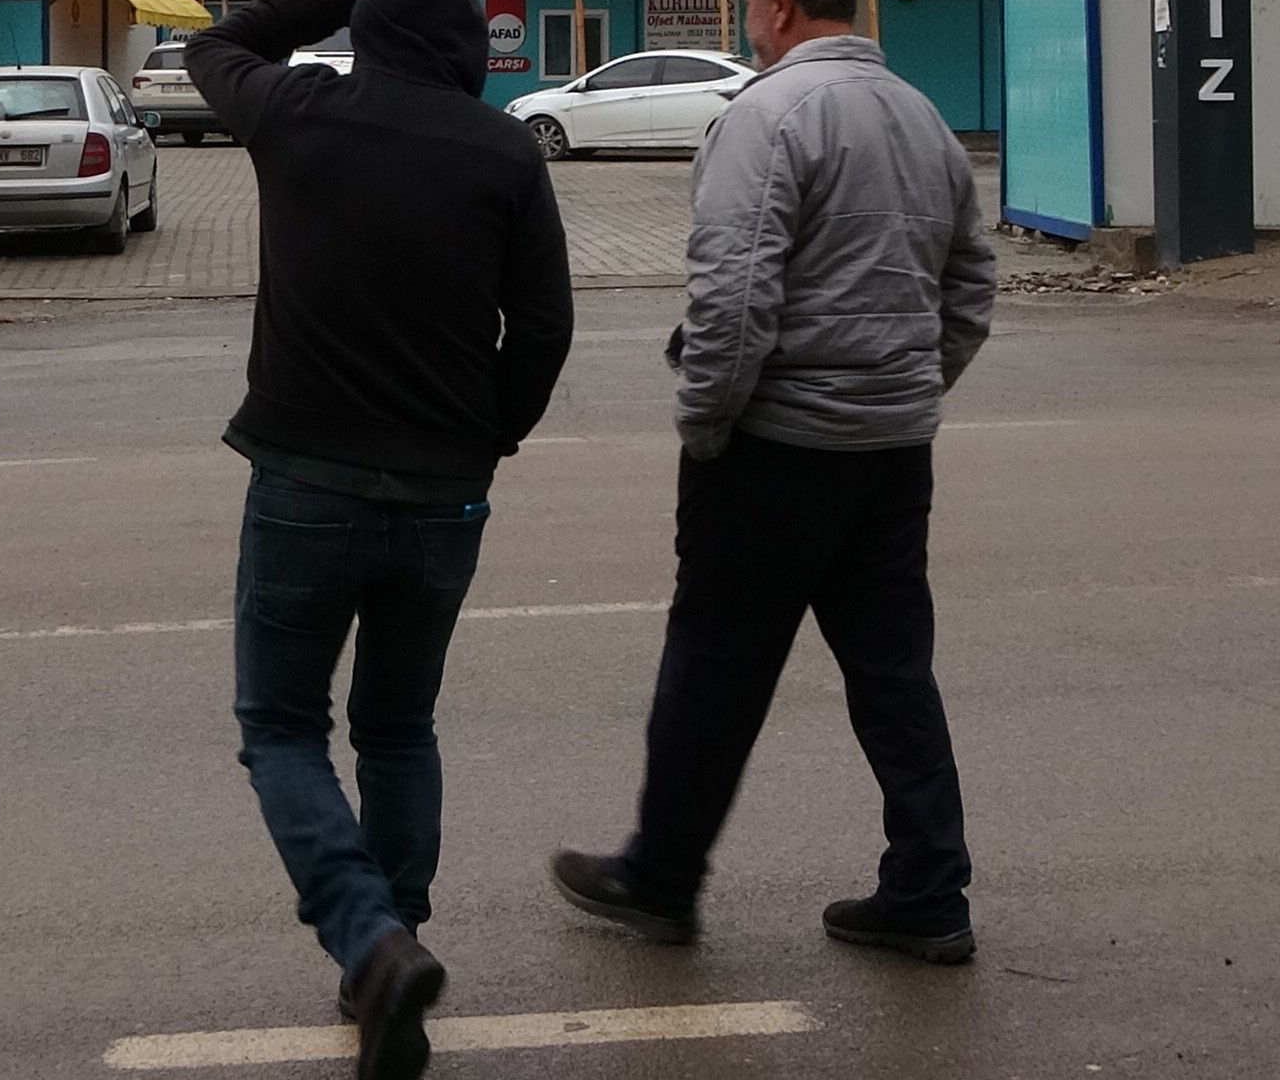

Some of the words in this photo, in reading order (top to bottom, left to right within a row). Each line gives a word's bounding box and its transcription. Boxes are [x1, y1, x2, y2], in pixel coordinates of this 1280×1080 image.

[647, 15, 674, 27] Ofset
[490, 28, 521, 39] AFAD
[487, 59, 524, 70] ÇARŞI
